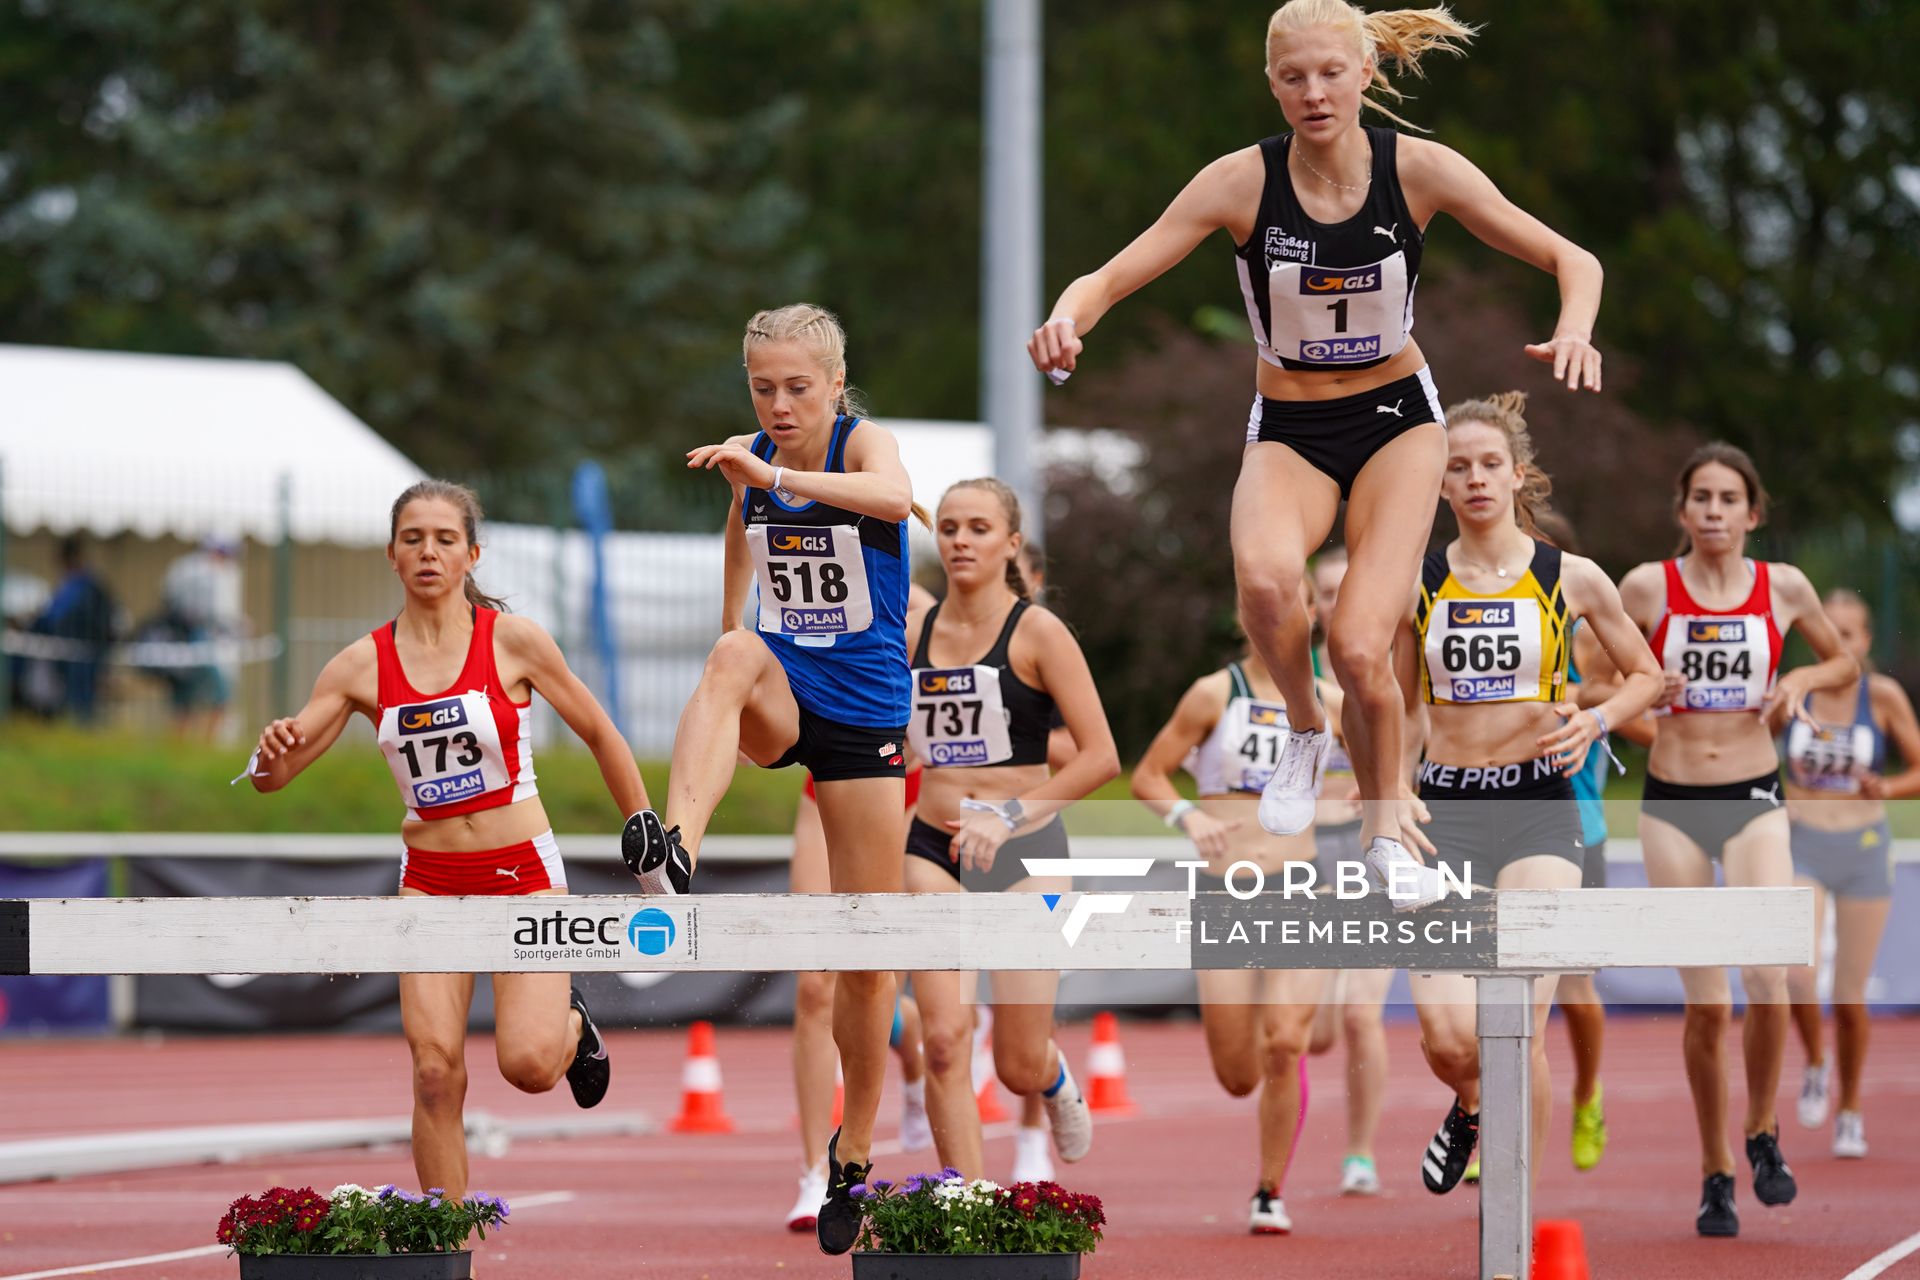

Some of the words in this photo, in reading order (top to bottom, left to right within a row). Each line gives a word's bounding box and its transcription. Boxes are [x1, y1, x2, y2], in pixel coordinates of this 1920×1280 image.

[1265, 244, 1308, 262] Freiburg
[1343, 273, 1376, 289] GLS
[1326, 298, 1348, 333] 1
[1333, 340, 1377, 354] PLAN
[802, 536, 827, 551] GLS
[767, 562, 848, 603] 518
[804, 612, 844, 625] PLAN
[1482, 608, 1510, 624] GLS
[1442, 634, 1521, 672] 665
[1681, 650, 1752, 681] 864
[946, 675, 972, 691] GLS
[1476, 678, 1513, 692] PLAN
[432, 705, 460, 726] GLS
[917, 700, 983, 737] 737
[398, 731, 483, 778] 173
[952, 743, 985, 757] PLAN
[1239, 732, 1278, 764] 41
[441, 774, 481, 794] PLAN
[1419, 759, 1458, 788] IKE
[1460, 764, 1522, 790] PRO
[514, 910, 619, 946] artec
[514, 948, 582, 961] Sportgeräte
[586, 949, 621, 959] GmbH
